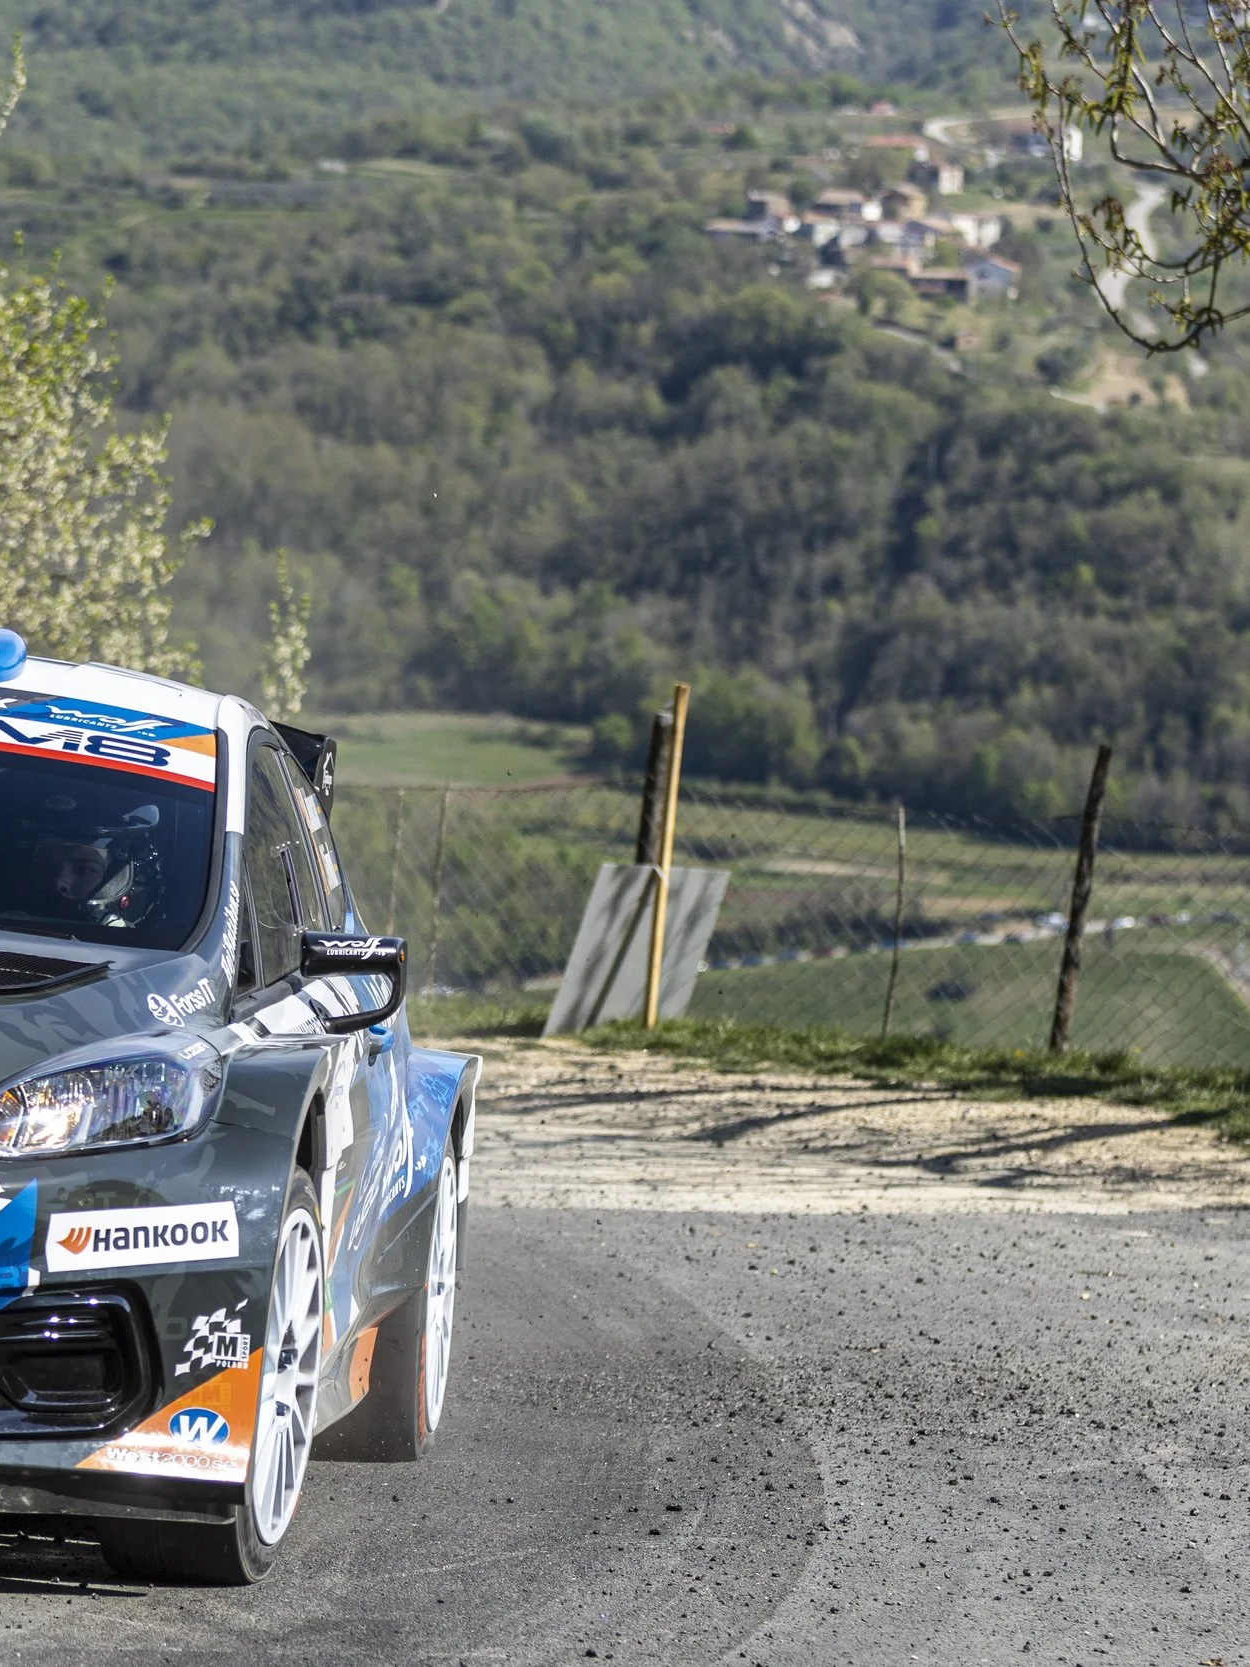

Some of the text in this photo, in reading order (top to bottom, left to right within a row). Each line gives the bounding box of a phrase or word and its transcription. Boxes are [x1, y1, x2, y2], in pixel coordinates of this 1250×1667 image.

[50, 713, 119, 730] LUBRICANTS
[241, 1336, 249, 1359] SPORT
[216, 1359, 248, 1370] POLAND
[179, 1415, 225, 1446] W
